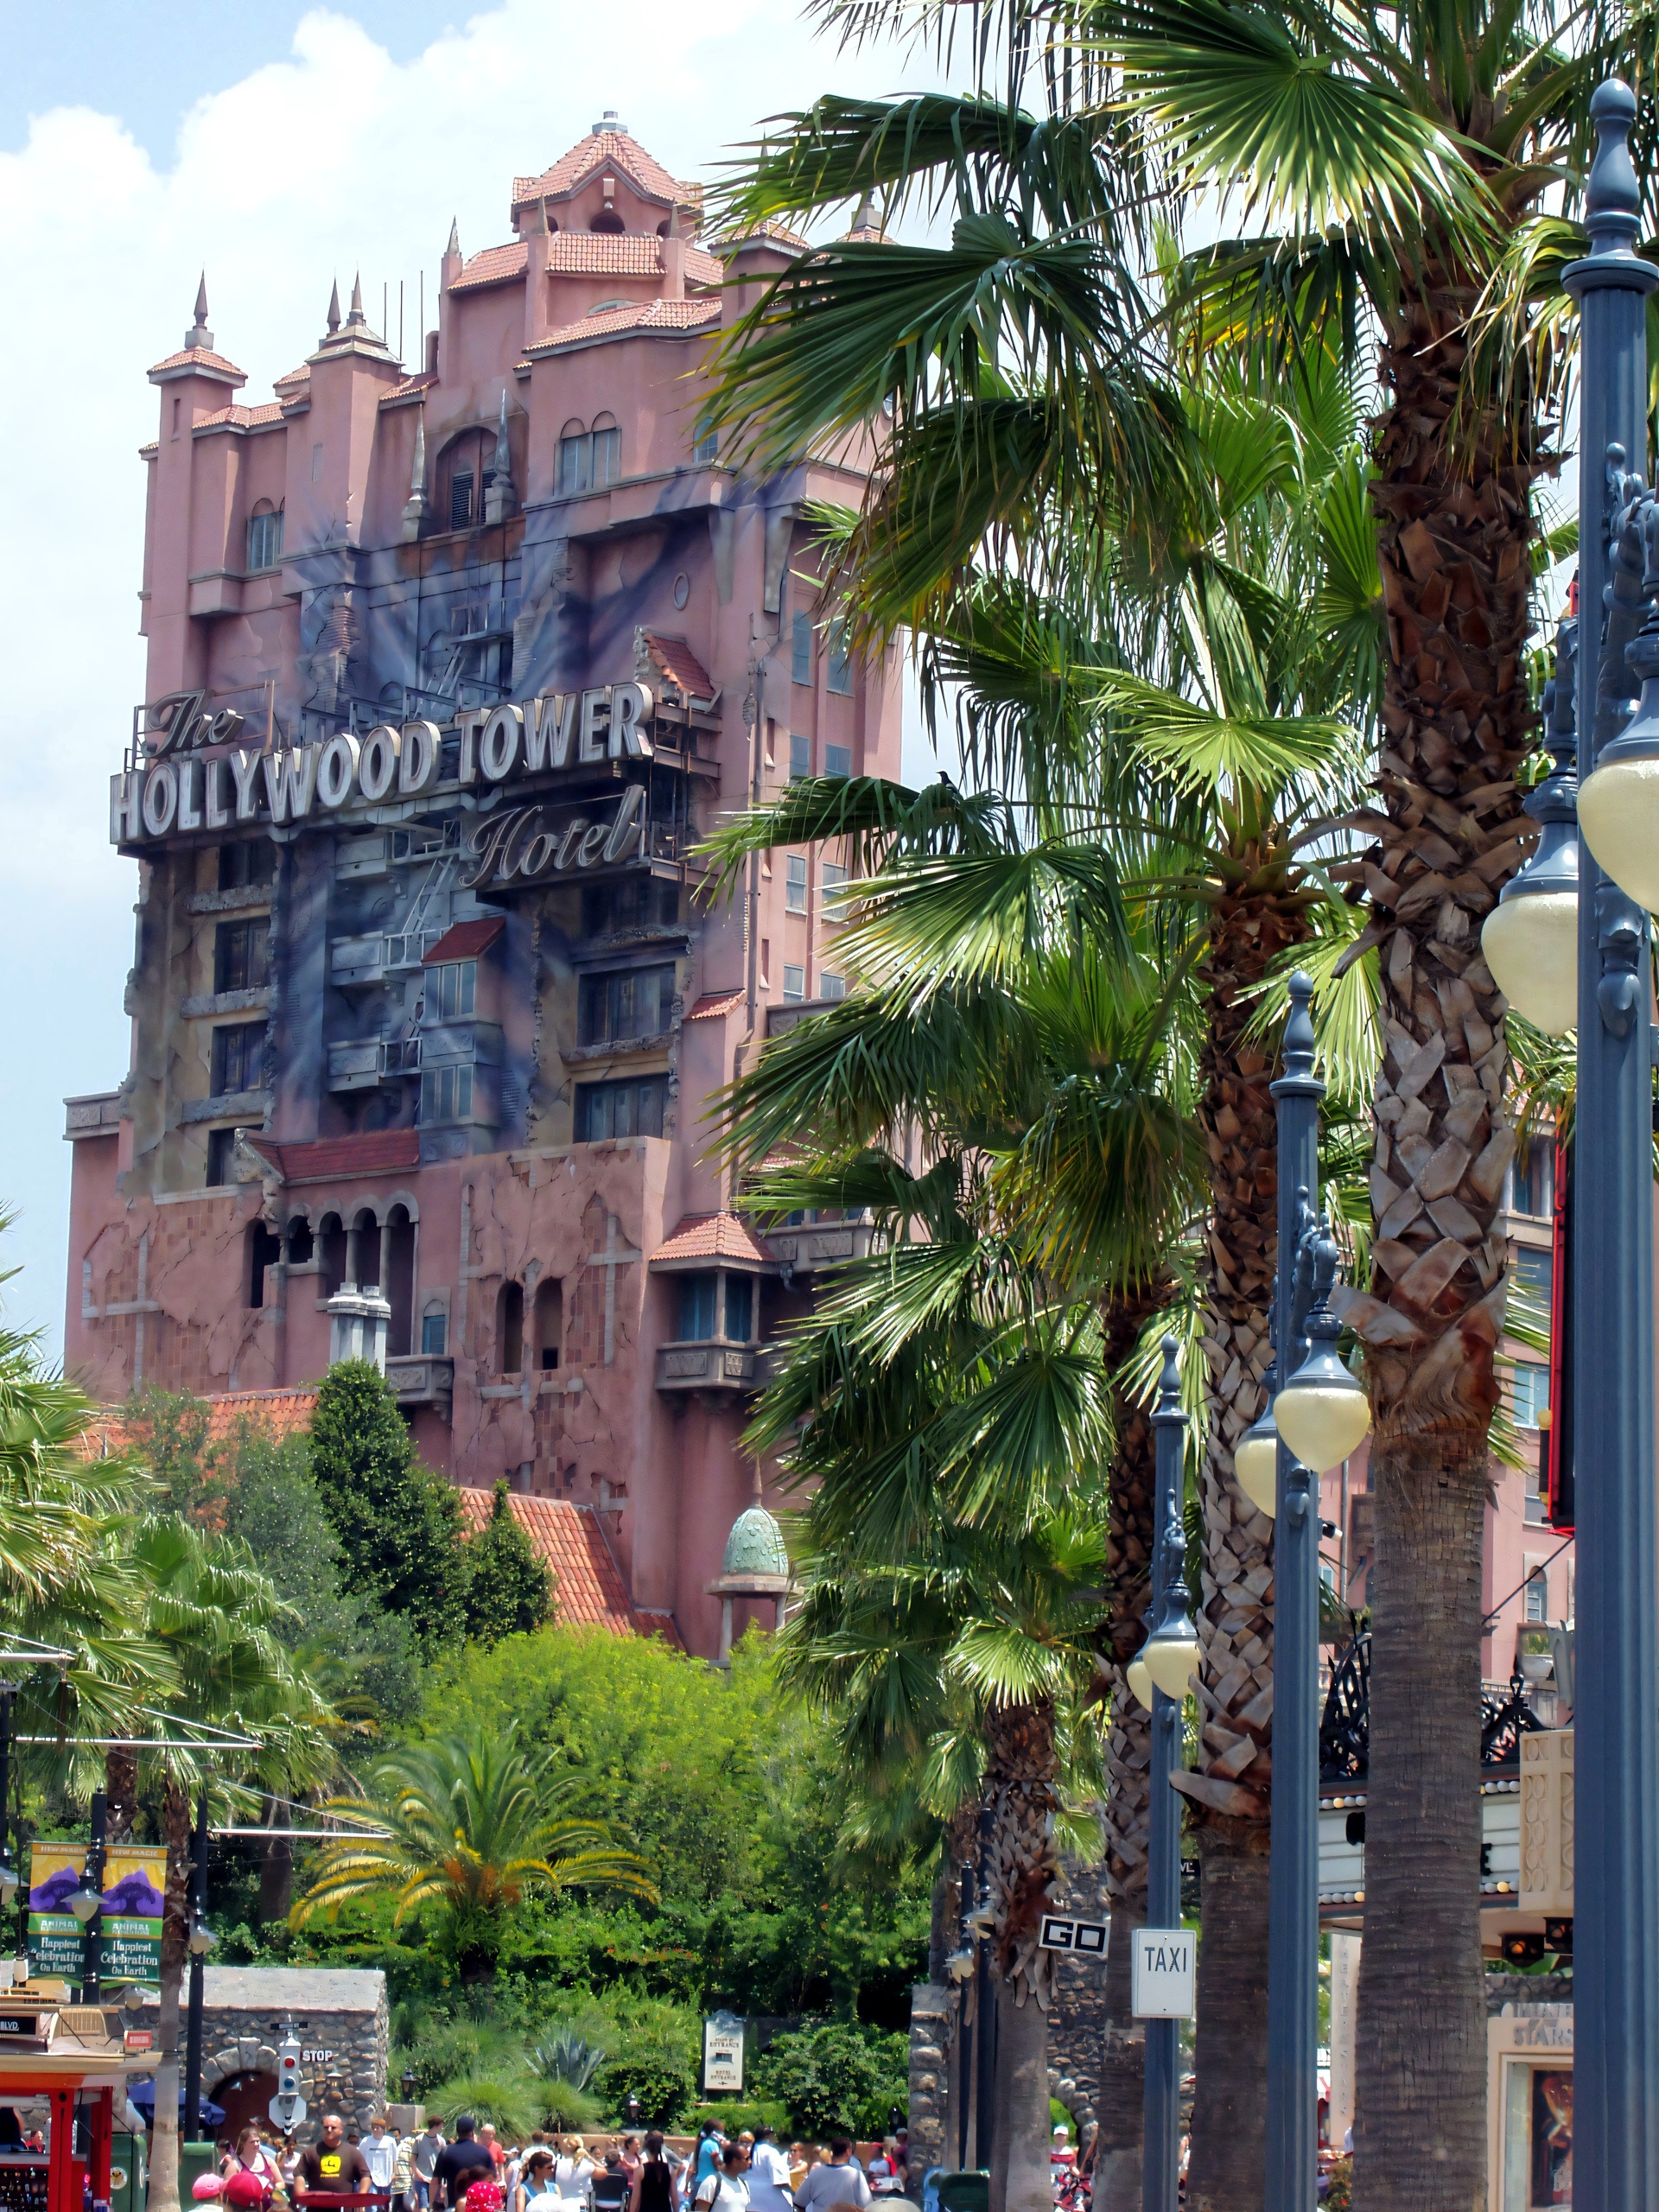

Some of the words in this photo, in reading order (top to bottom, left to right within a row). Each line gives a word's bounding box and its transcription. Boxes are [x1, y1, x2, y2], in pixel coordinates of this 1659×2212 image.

[139, 689, 245, 758] The
[110, 720, 442, 845] HOLLYWOOD
[454, 682, 653, 784] TOWER
[459, 785, 645, 887] Hotel
[1042, 1918, 1106, 1953] GO
[41, 1937, 80, 1951] Happiest
[113, 1940, 151, 1954] Happiest
[100, 1951, 157, 1966] Celebration
[1144, 1947, 1187, 1973] TAXI
[40, 1963, 51, 1973] On
[52, 1962, 76, 1974] Earth
[111, 1966, 123, 1975] On
[124, 1965, 147, 1976] Earth
[302, 2050, 333, 2062] STOP
